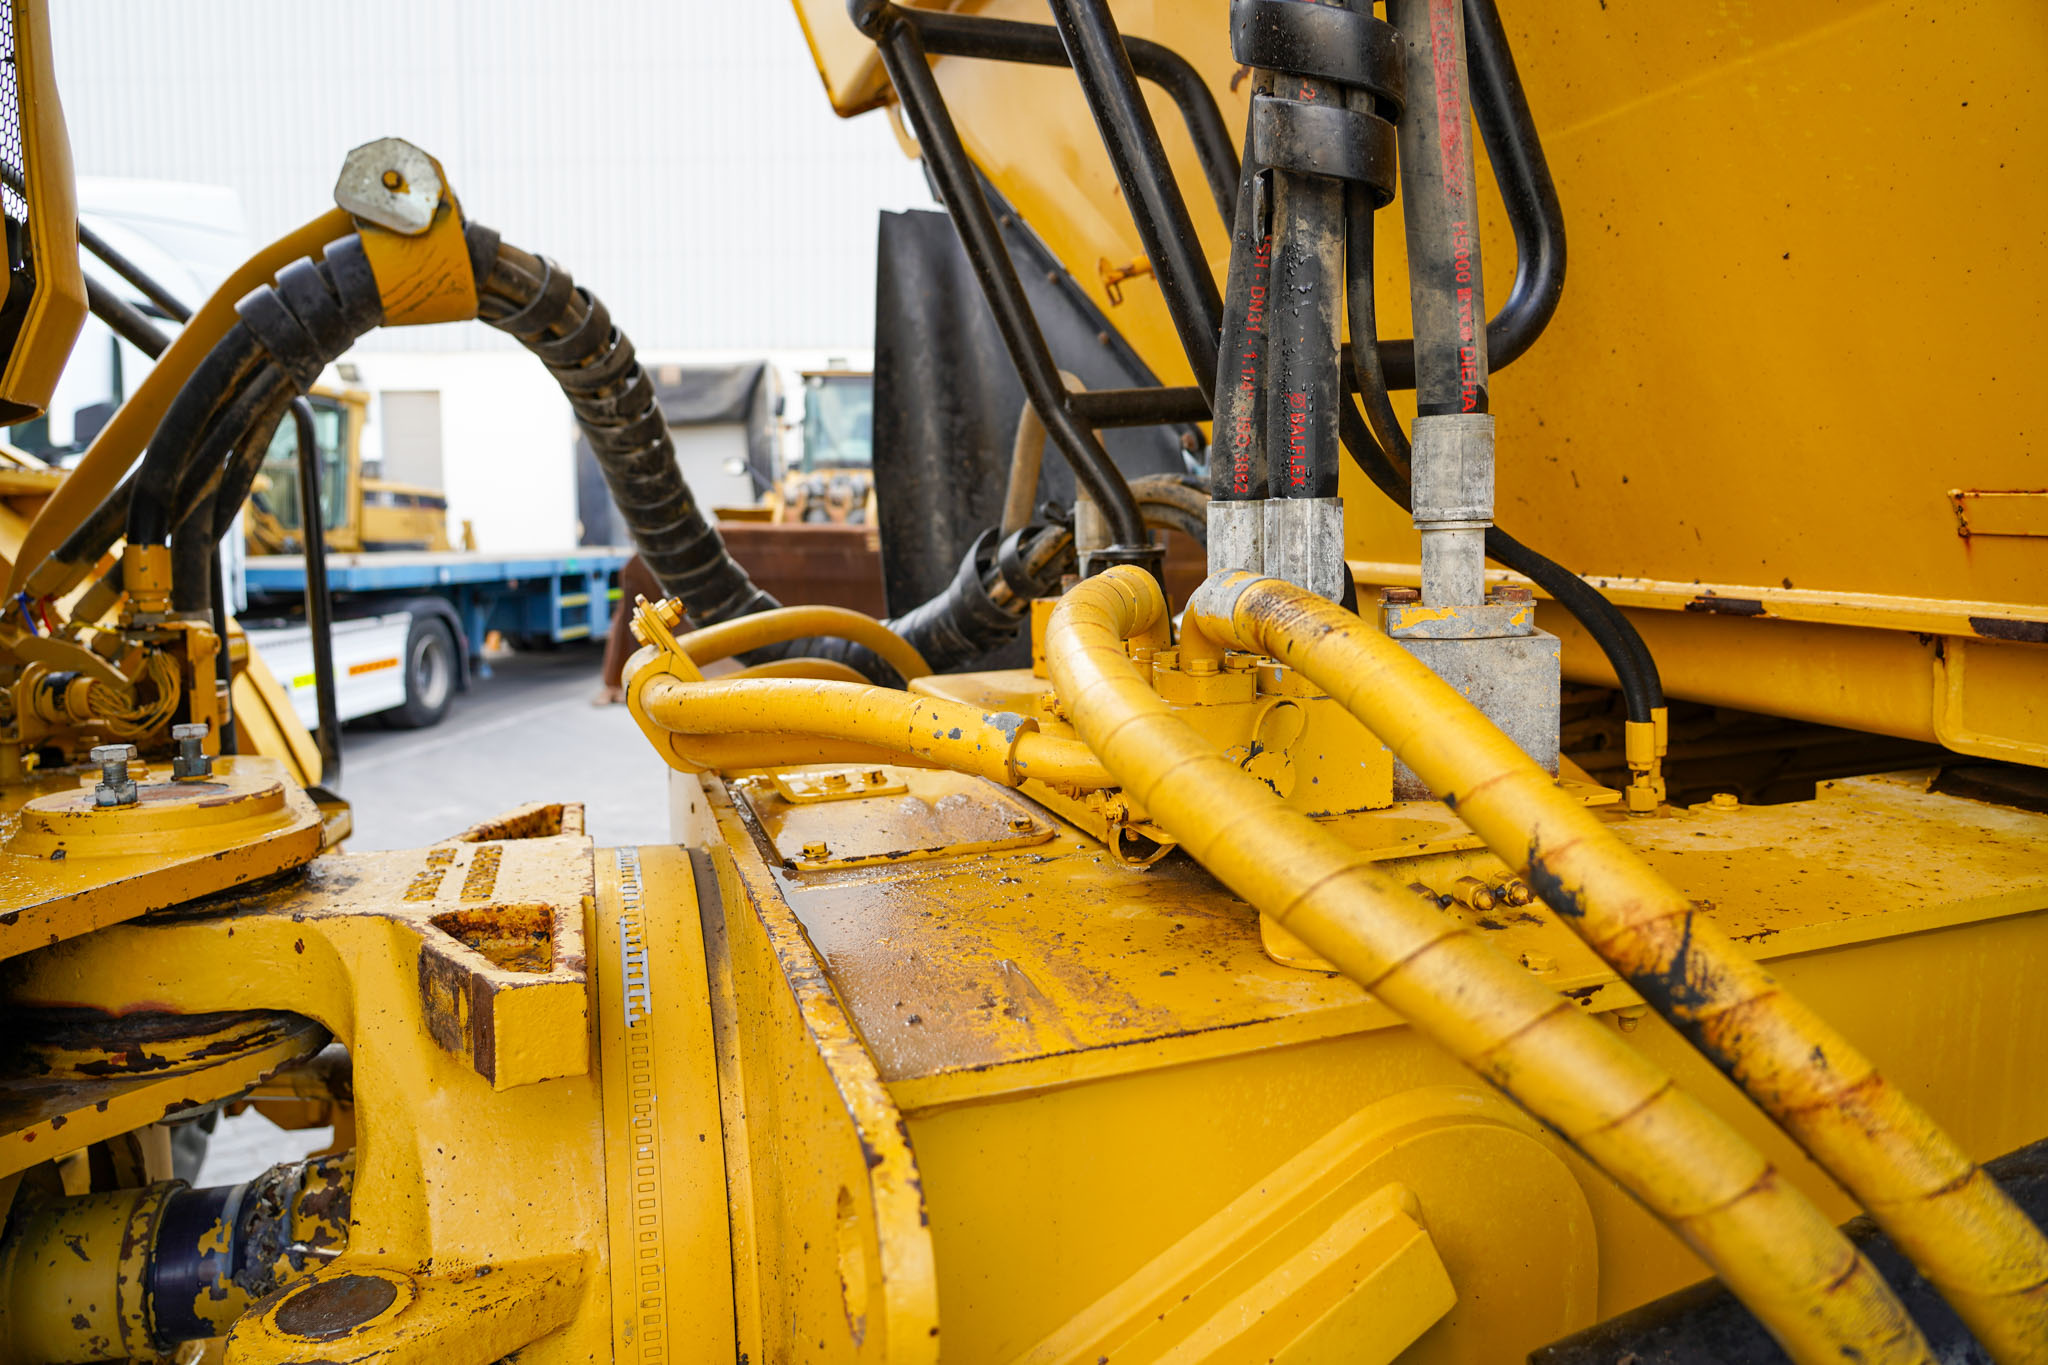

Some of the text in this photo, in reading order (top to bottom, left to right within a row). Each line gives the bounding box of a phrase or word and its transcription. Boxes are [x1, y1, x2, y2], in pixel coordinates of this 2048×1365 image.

[1451, 221, 1472, 283] H5000
[1246, 286, 1265, 332] DN31
[1459, 346, 1478, 415] DIEHA
[1236, 417, 1252, 448] ISO
[1290, 413, 1306, 488] BALFLEX
[1234, 453, 1250, 495] 3862
